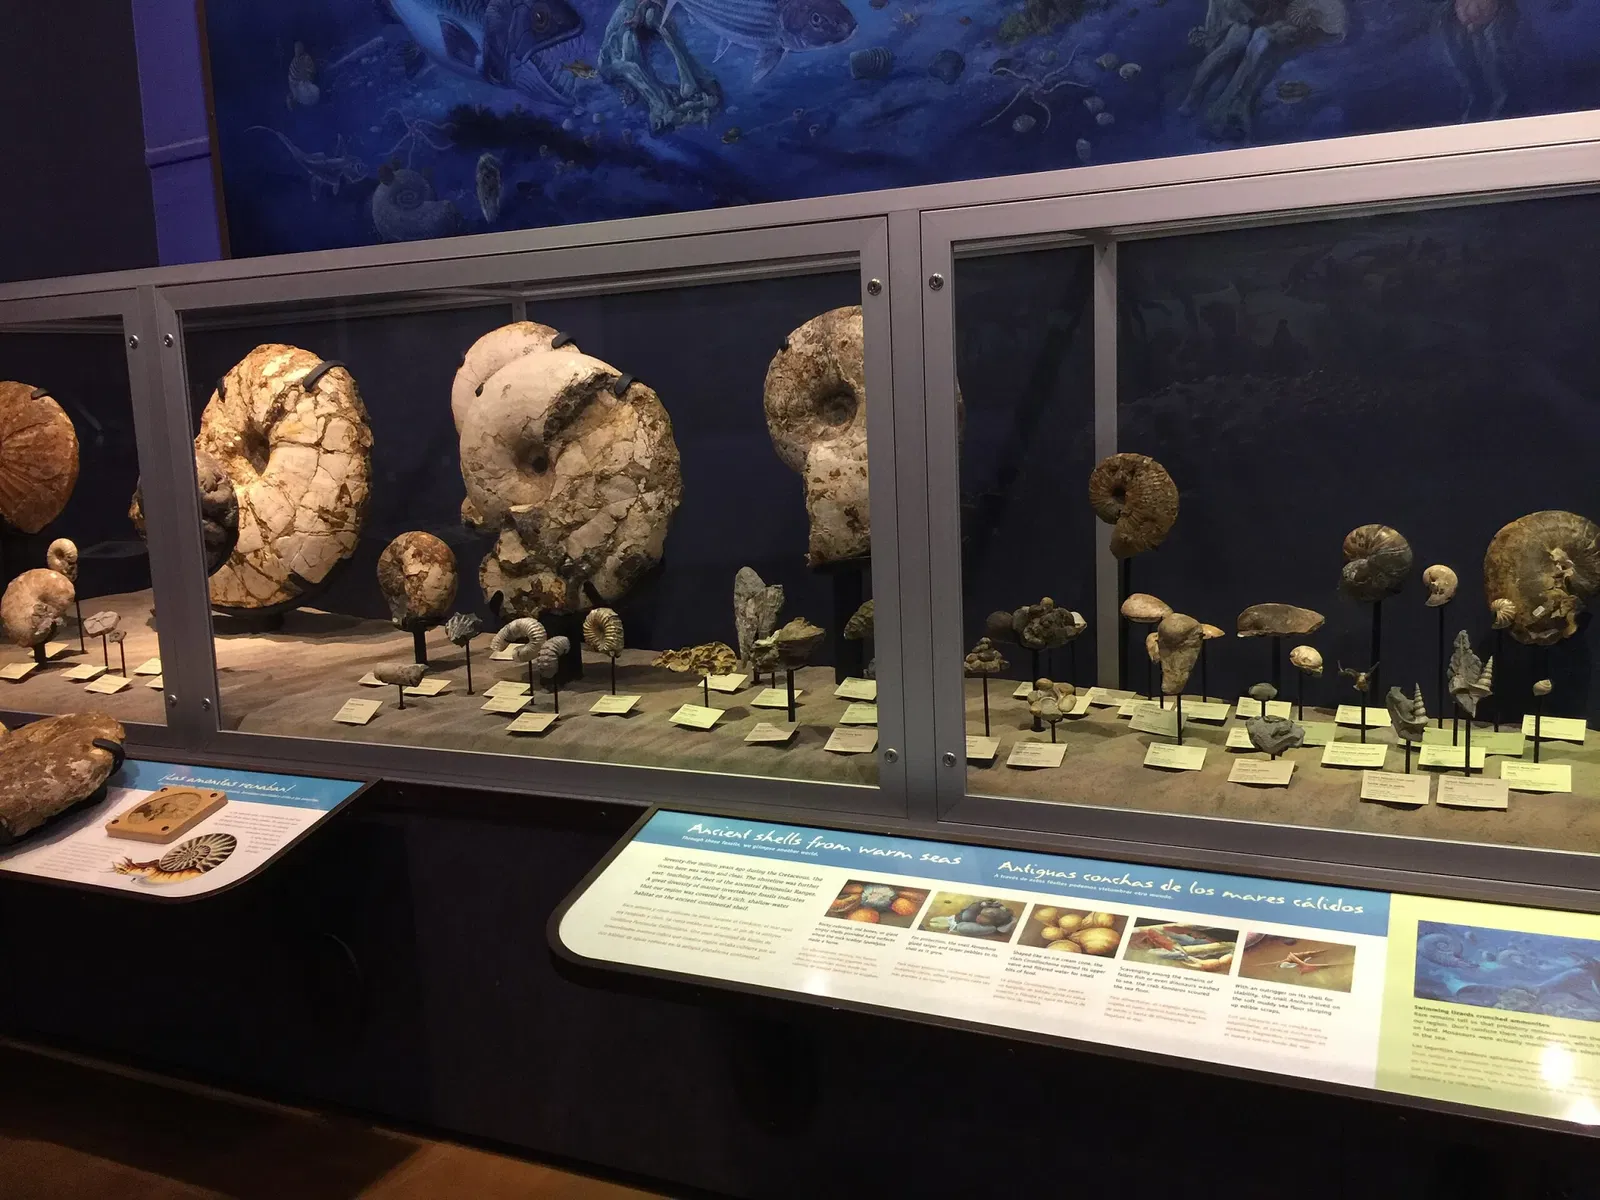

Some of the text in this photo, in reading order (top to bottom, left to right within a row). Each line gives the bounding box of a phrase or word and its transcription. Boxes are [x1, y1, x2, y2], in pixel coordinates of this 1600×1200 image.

[186, 777, 237, 786] amonitas
[238, 782, 295, 792] reinaban!
[687, 823, 962, 864] Ancient shells from warm seas
[998, 861, 1364, 913] Antiguas conchas de los mares cálidos
